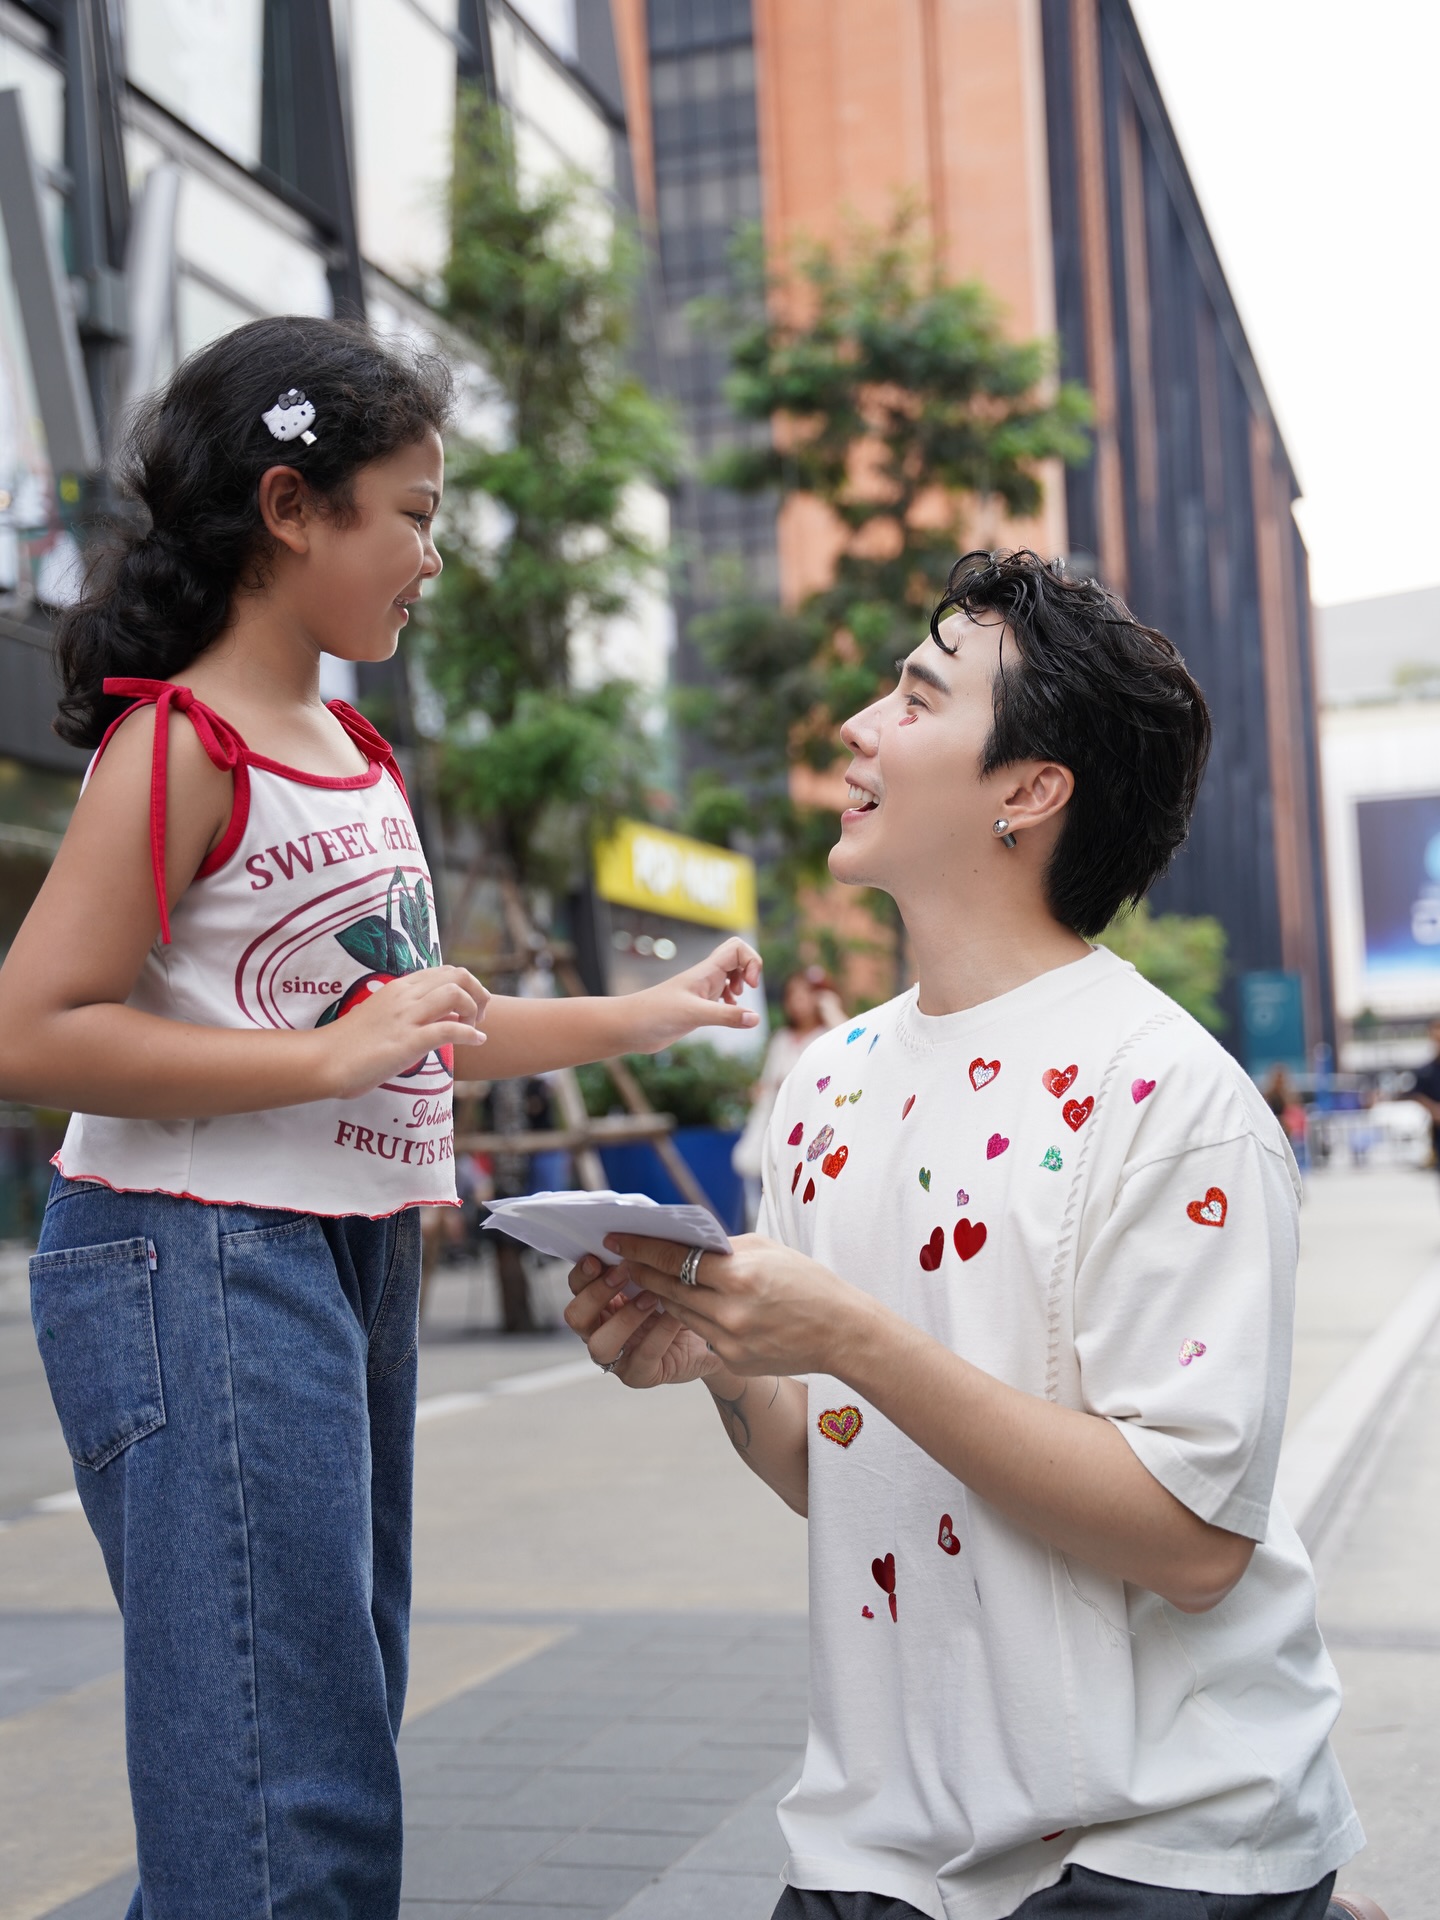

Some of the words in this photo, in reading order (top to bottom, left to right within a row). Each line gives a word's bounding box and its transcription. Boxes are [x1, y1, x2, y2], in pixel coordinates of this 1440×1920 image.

[245, 822, 378, 891] SWEET
[380, 816, 420, 852] CHE
[282, 976, 343, 995] since
[334, 1120, 436, 1166] FRUITS
